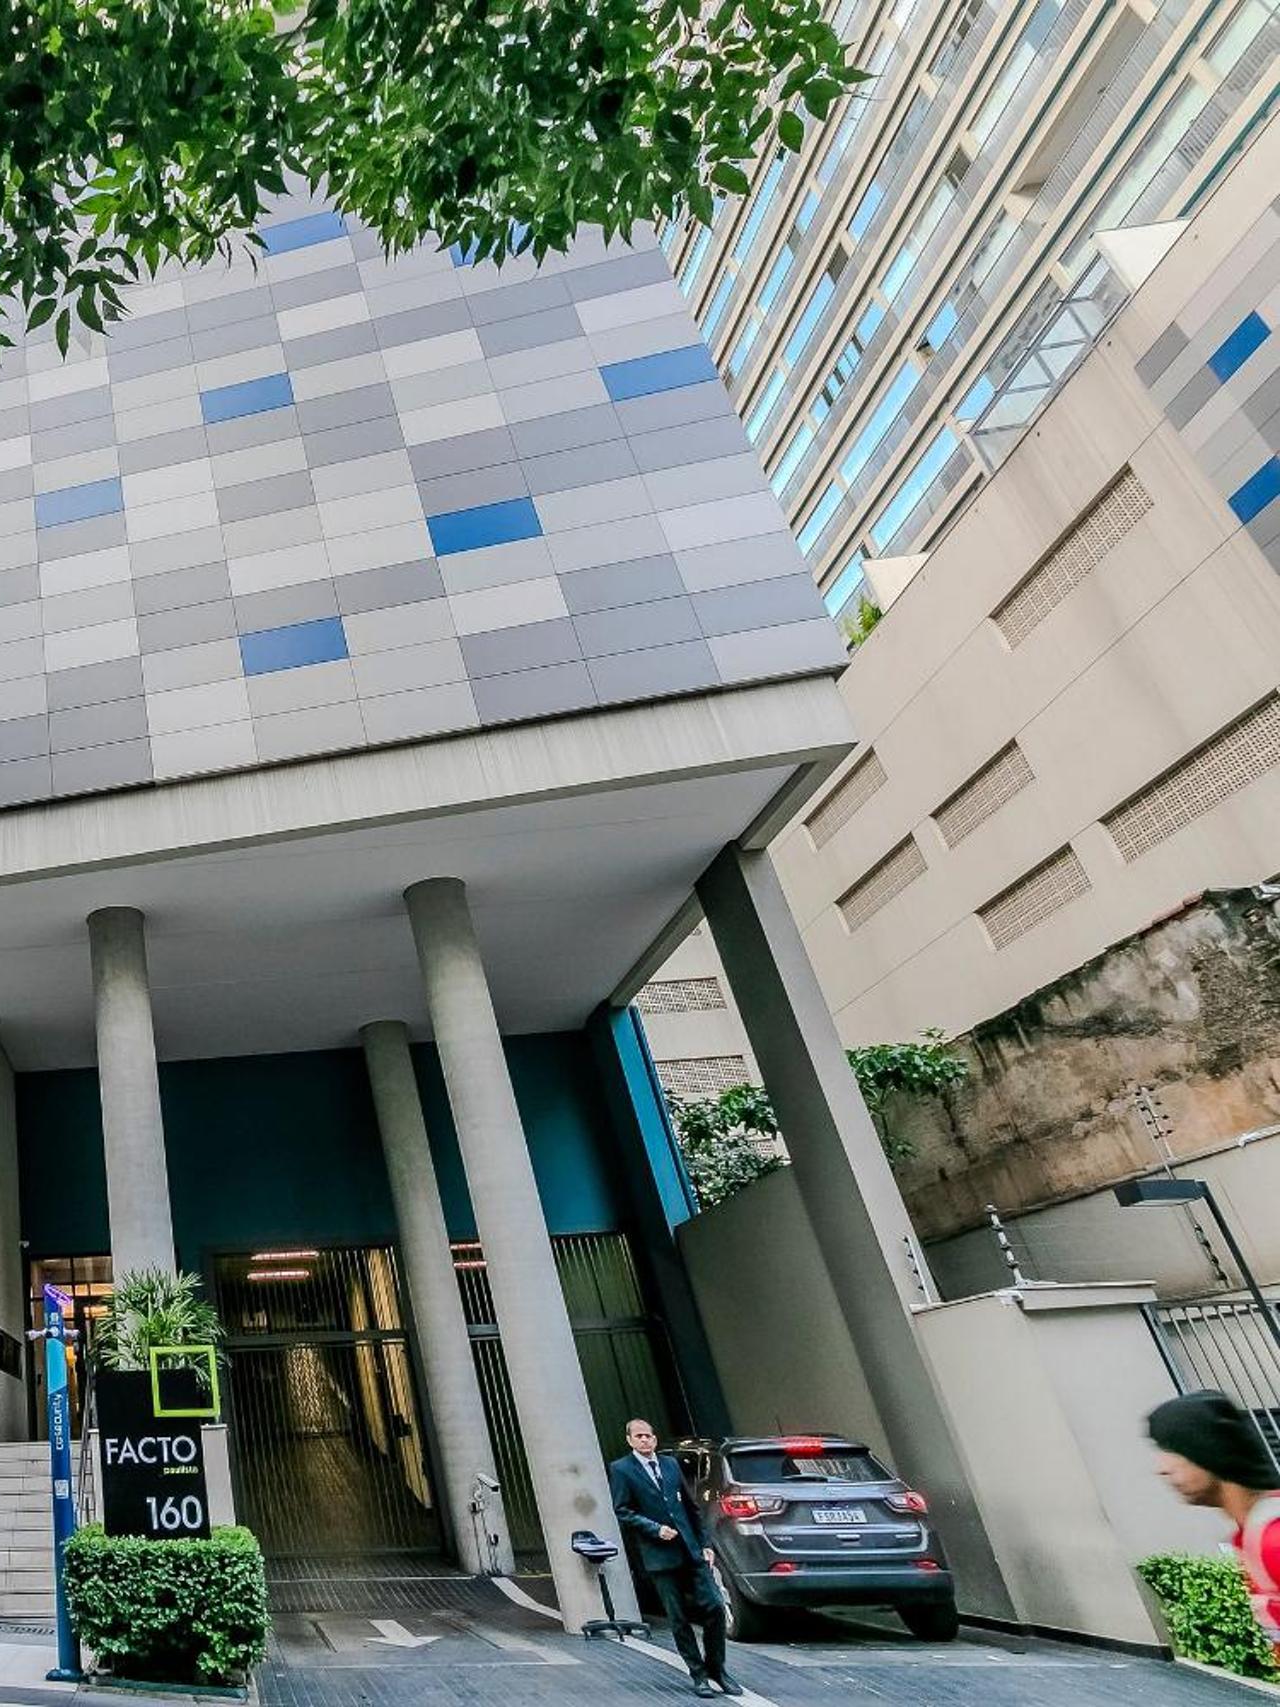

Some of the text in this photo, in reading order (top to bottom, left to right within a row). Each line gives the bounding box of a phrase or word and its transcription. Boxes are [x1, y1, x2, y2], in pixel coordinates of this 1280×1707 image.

[104, 1435, 197, 1465] FACTO
[163, 1465, 199, 1475] paulista
[146, 1495, 203, 1530] 160
